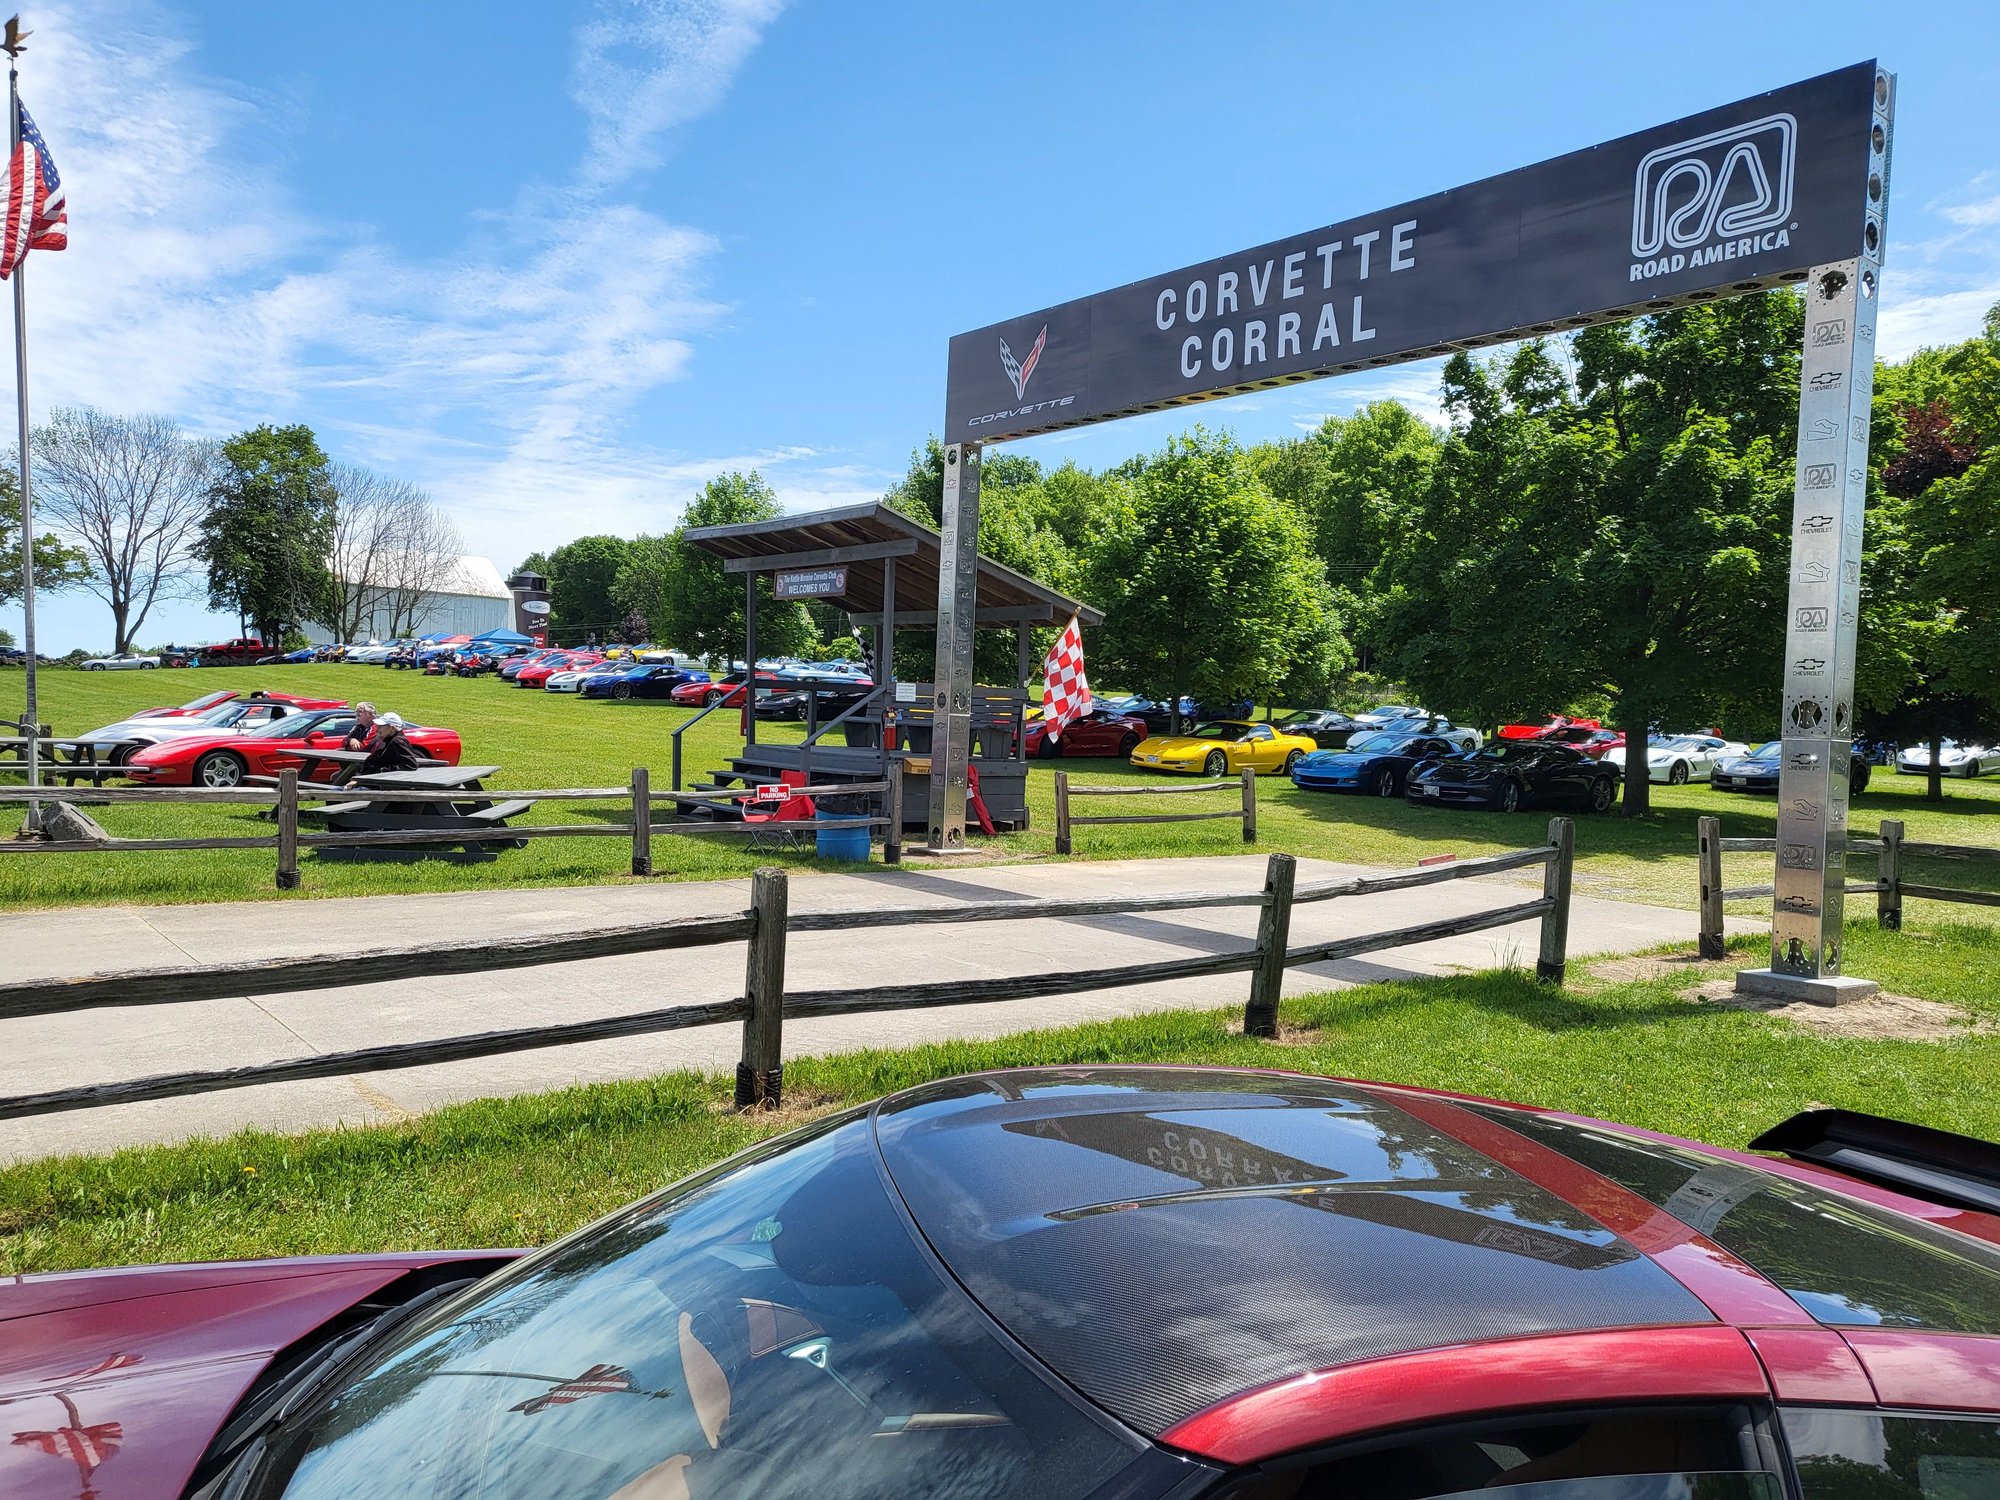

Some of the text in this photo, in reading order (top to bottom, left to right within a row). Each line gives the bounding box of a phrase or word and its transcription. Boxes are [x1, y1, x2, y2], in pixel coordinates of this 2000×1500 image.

[1156, 219, 1418, 331] CORVETTE
[1629, 229, 1790, 282] ROAD AMERICA
[1180, 295, 1377, 378] CORRAL
[968, 395, 1076, 426] CORVETTE
[789, 583, 830, 594] WELCOMES YOU
